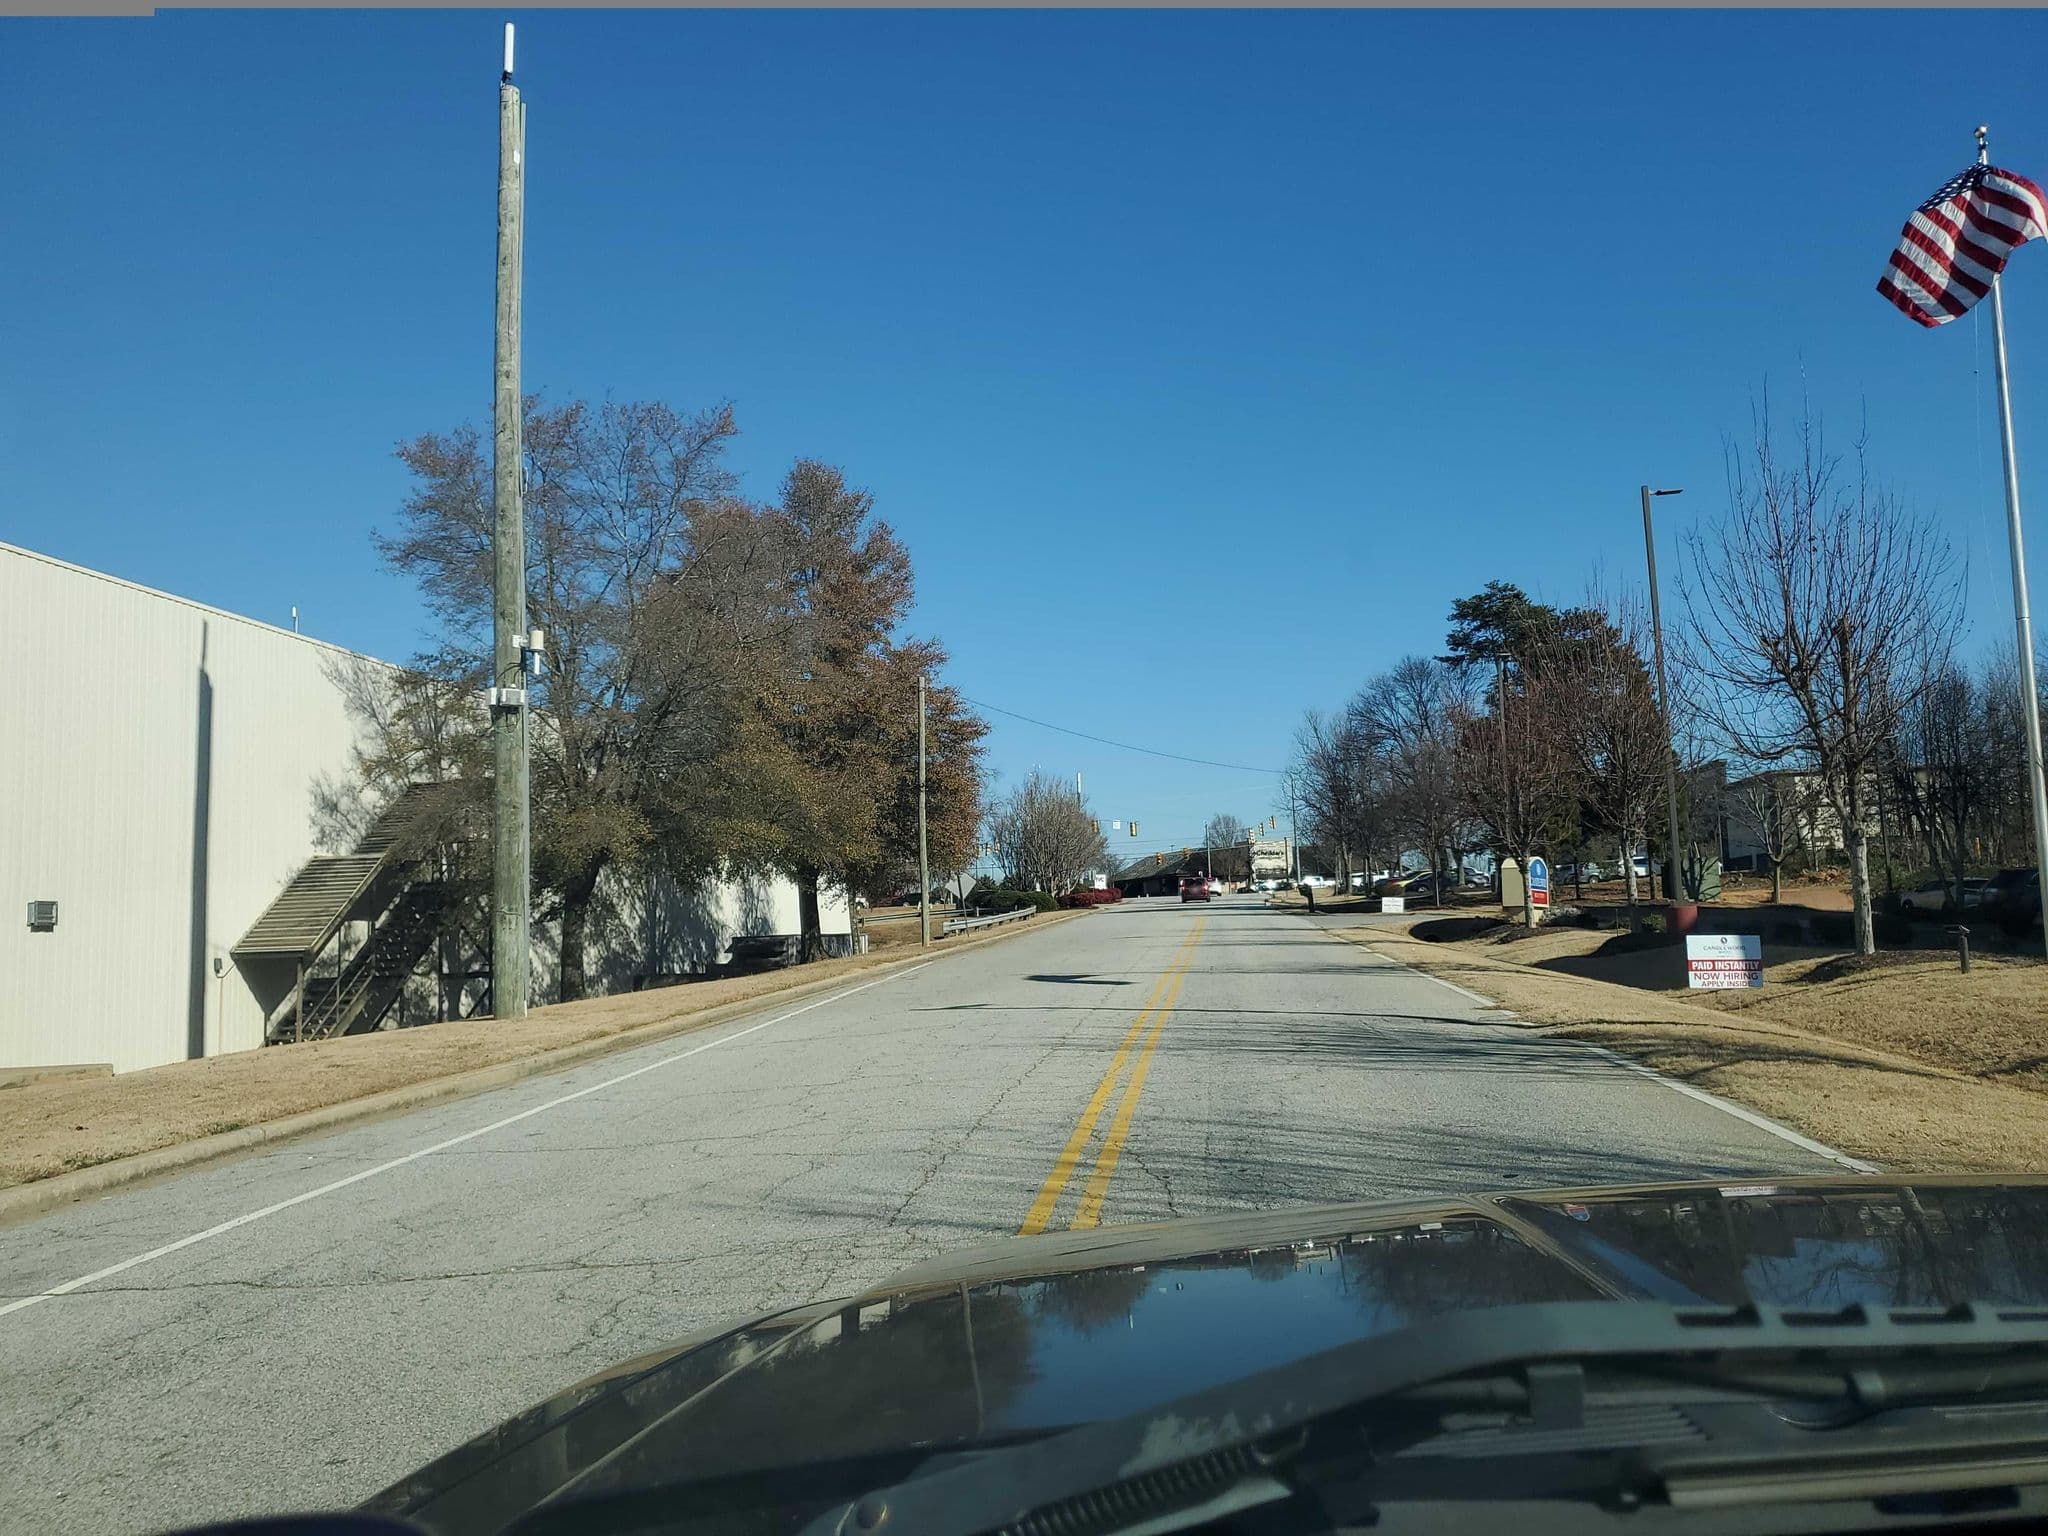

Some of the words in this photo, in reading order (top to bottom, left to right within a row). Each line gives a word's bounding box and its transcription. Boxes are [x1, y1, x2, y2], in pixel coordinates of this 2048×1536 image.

[1692, 961, 1713, 970] PAID
[1715, 961, 1759, 970] INSTANTLY
[1694, 972, 1720, 980] NOW
[1723, 972, 1758, 980] HIRING
